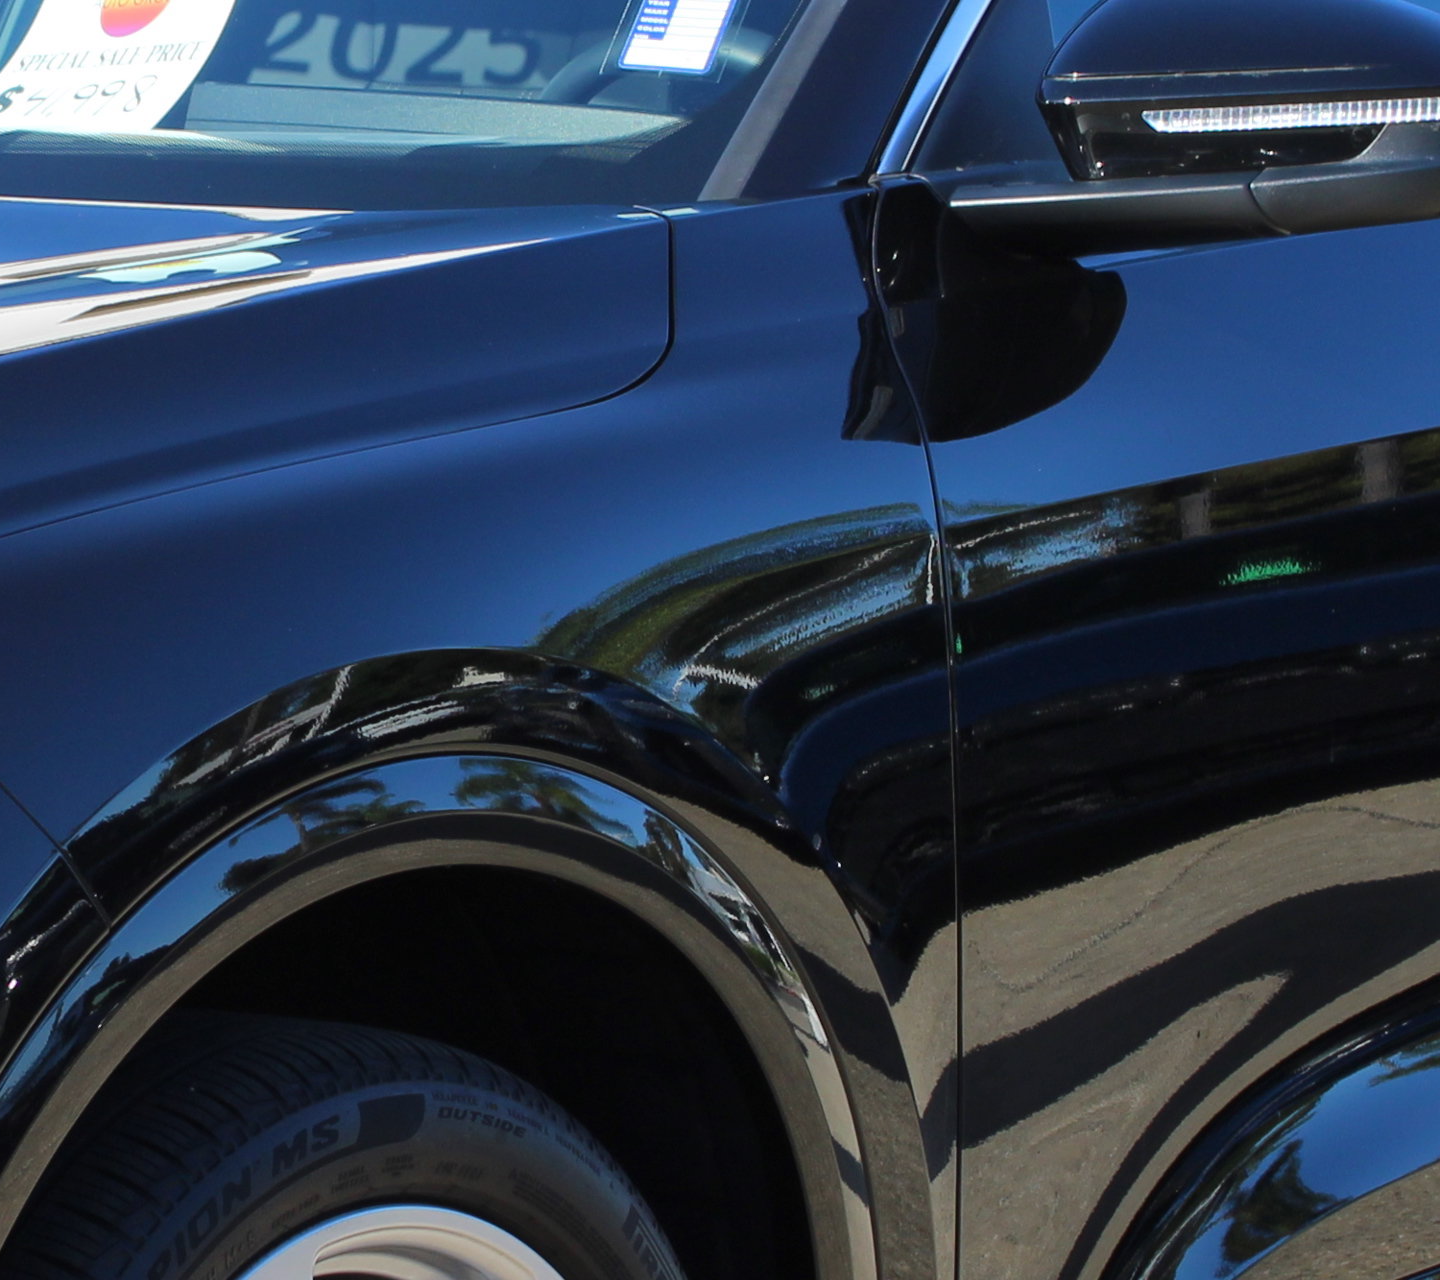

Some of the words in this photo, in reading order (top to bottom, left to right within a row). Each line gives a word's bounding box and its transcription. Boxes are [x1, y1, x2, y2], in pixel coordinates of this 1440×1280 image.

[18, 50, 91, 72] SPECIAL
[95, 46, 146, 67] SALE
[145, 39, 207, 64] PRICE
[437, 1106, 527, 1138] OUTSIDE
[270, 1114, 341, 1177] MS
